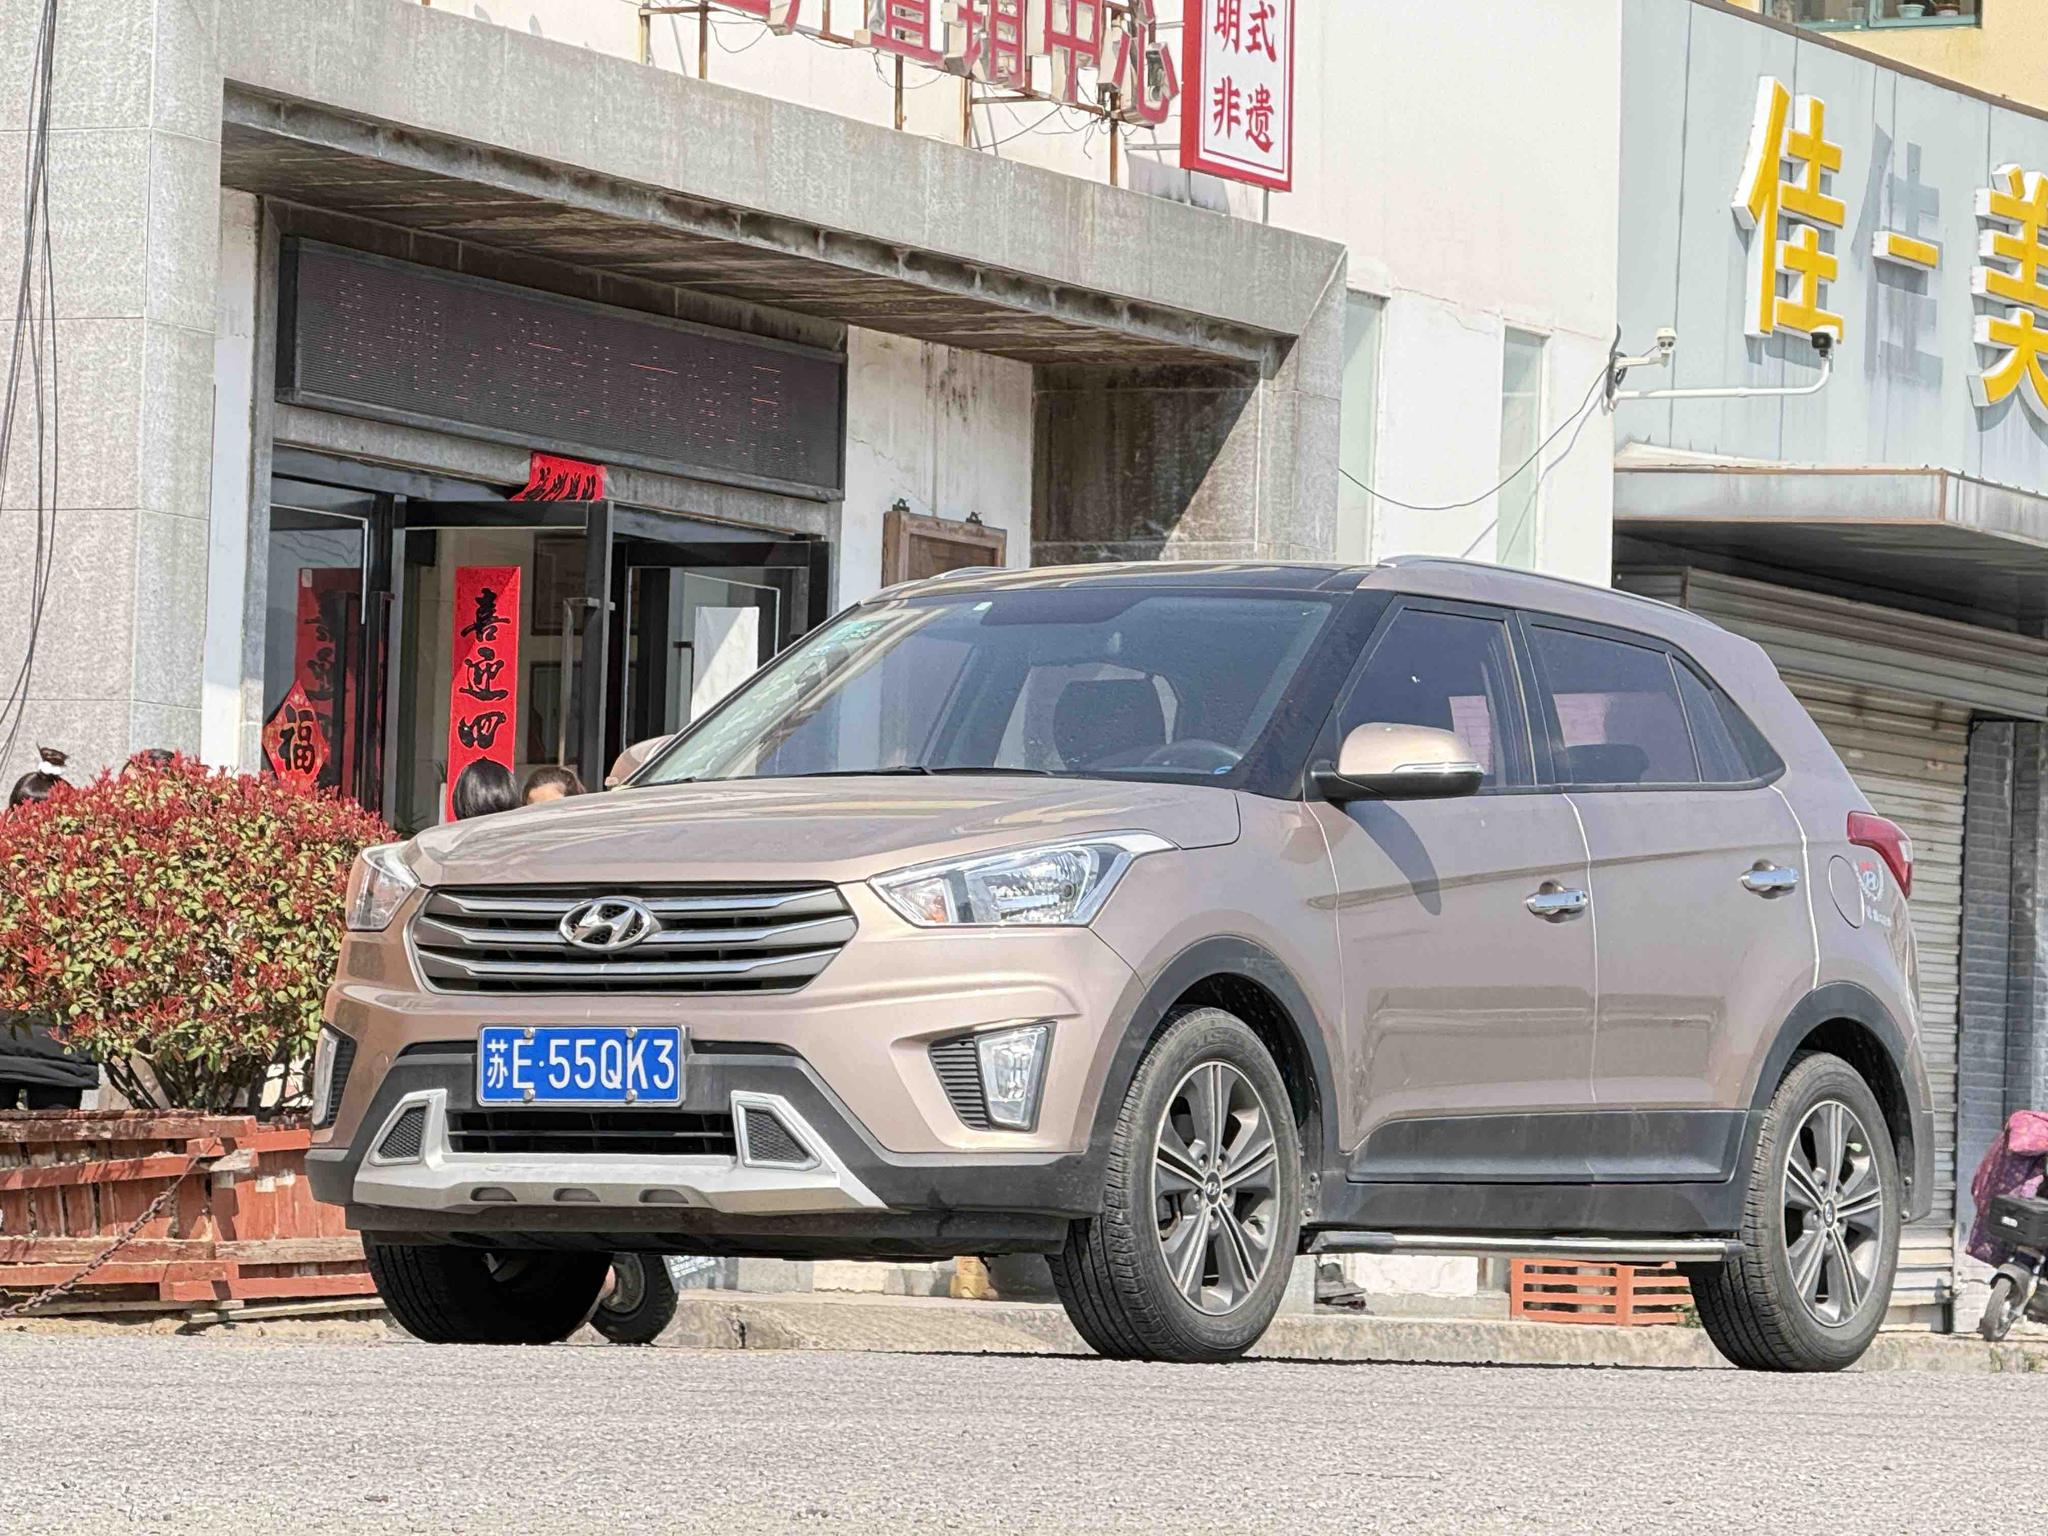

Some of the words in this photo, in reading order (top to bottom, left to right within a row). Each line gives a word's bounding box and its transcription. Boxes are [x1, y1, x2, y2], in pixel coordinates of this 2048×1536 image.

[1213, 0, 1277, 62] 明式
[1213, 75, 1275, 153] 非遗
[460, 587, 511, 750] 喜迎四
[278, 703, 316, 776] 福
[486, 1038, 676, 1090] 苏E·55QK3
